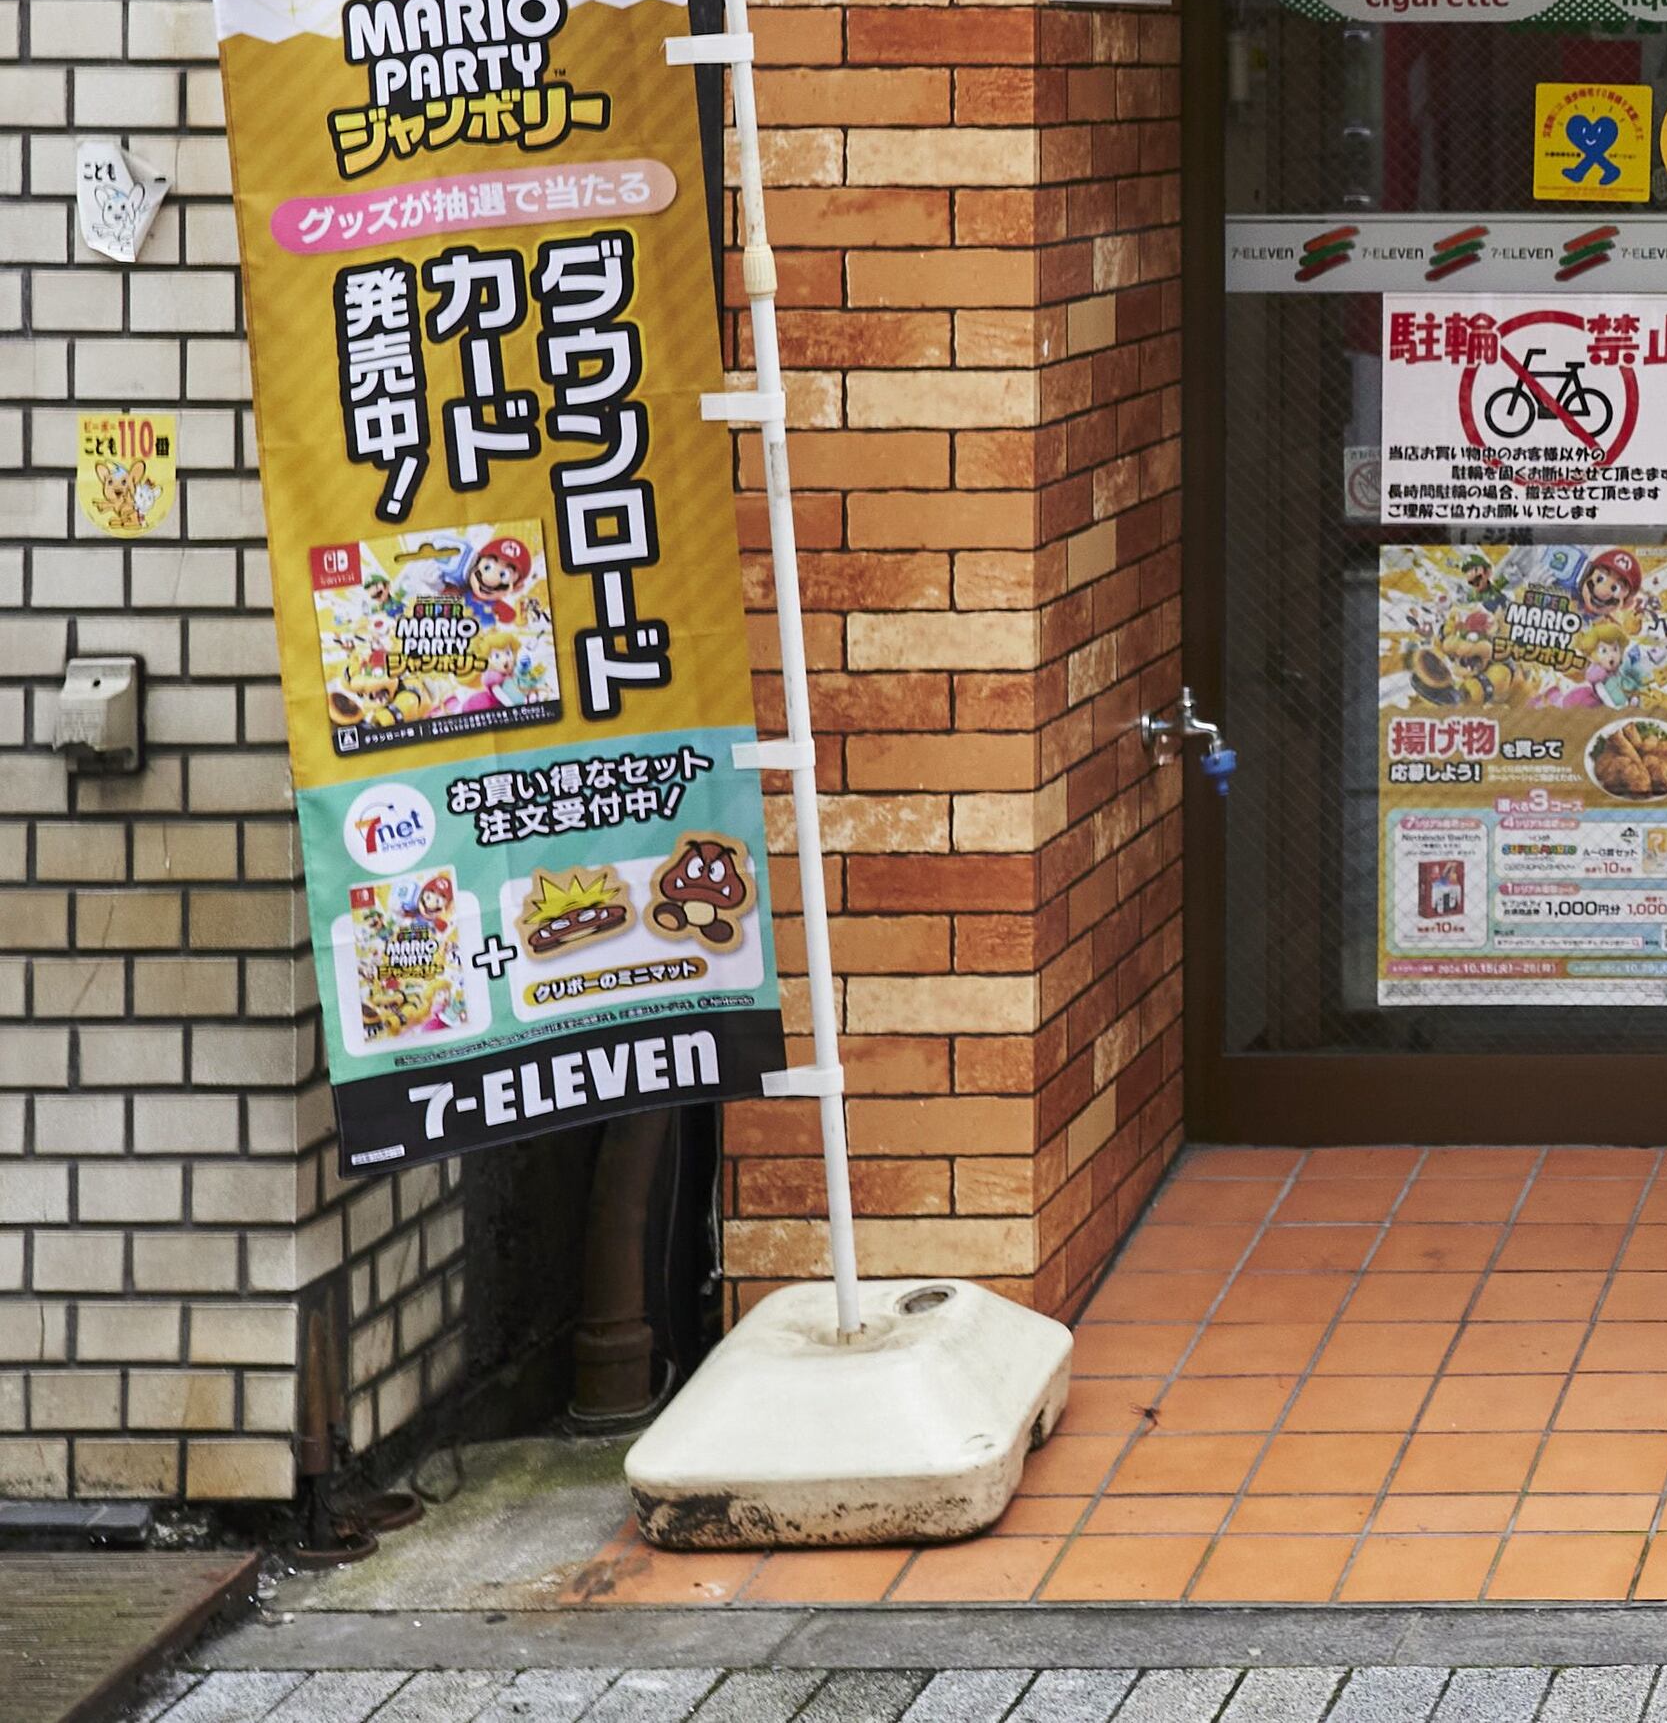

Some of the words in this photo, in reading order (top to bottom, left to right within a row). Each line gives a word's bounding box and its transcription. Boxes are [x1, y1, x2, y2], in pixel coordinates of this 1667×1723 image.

[375, 42, 543, 106] PARTY
[335, 86, 603, 170] ジャンボリー
[298, 170, 653, 244] グッズが抽選で当たる
[1389, 312, 1498, 365] 駐輪
[428, 254, 531, 484] カード
[1389, 445, 1606, 462] 当店お買い物中のお客様以外の
[541, 238, 662, 713] ダウンロード
[1388, 484, 1660, 502] 長時間駐輪の場合、撤去させて頂きます
[1388, 503, 1599, 520] ご理解ご協力お願いいたします
[414, 603, 463, 619] SUPER
[1524, 591, 1569, 611] SUPER
[397, 618, 479, 639] MARIO
[1506, 604, 1582, 633] MARIO
[404, 637, 468, 656] PARTY
[1510, 625, 1571, 649] PARTY
[386, 653, 489, 677] ジャンボリー
[1492, 638, 1587, 670] ジャンボリー
[1391, 720, 1496, 756] 揚げ物
[1502, 740, 1563, 759] を買って
[450, 748, 710, 813] お買い得なセット
[479, 785, 681, 844] 注文受付中!
